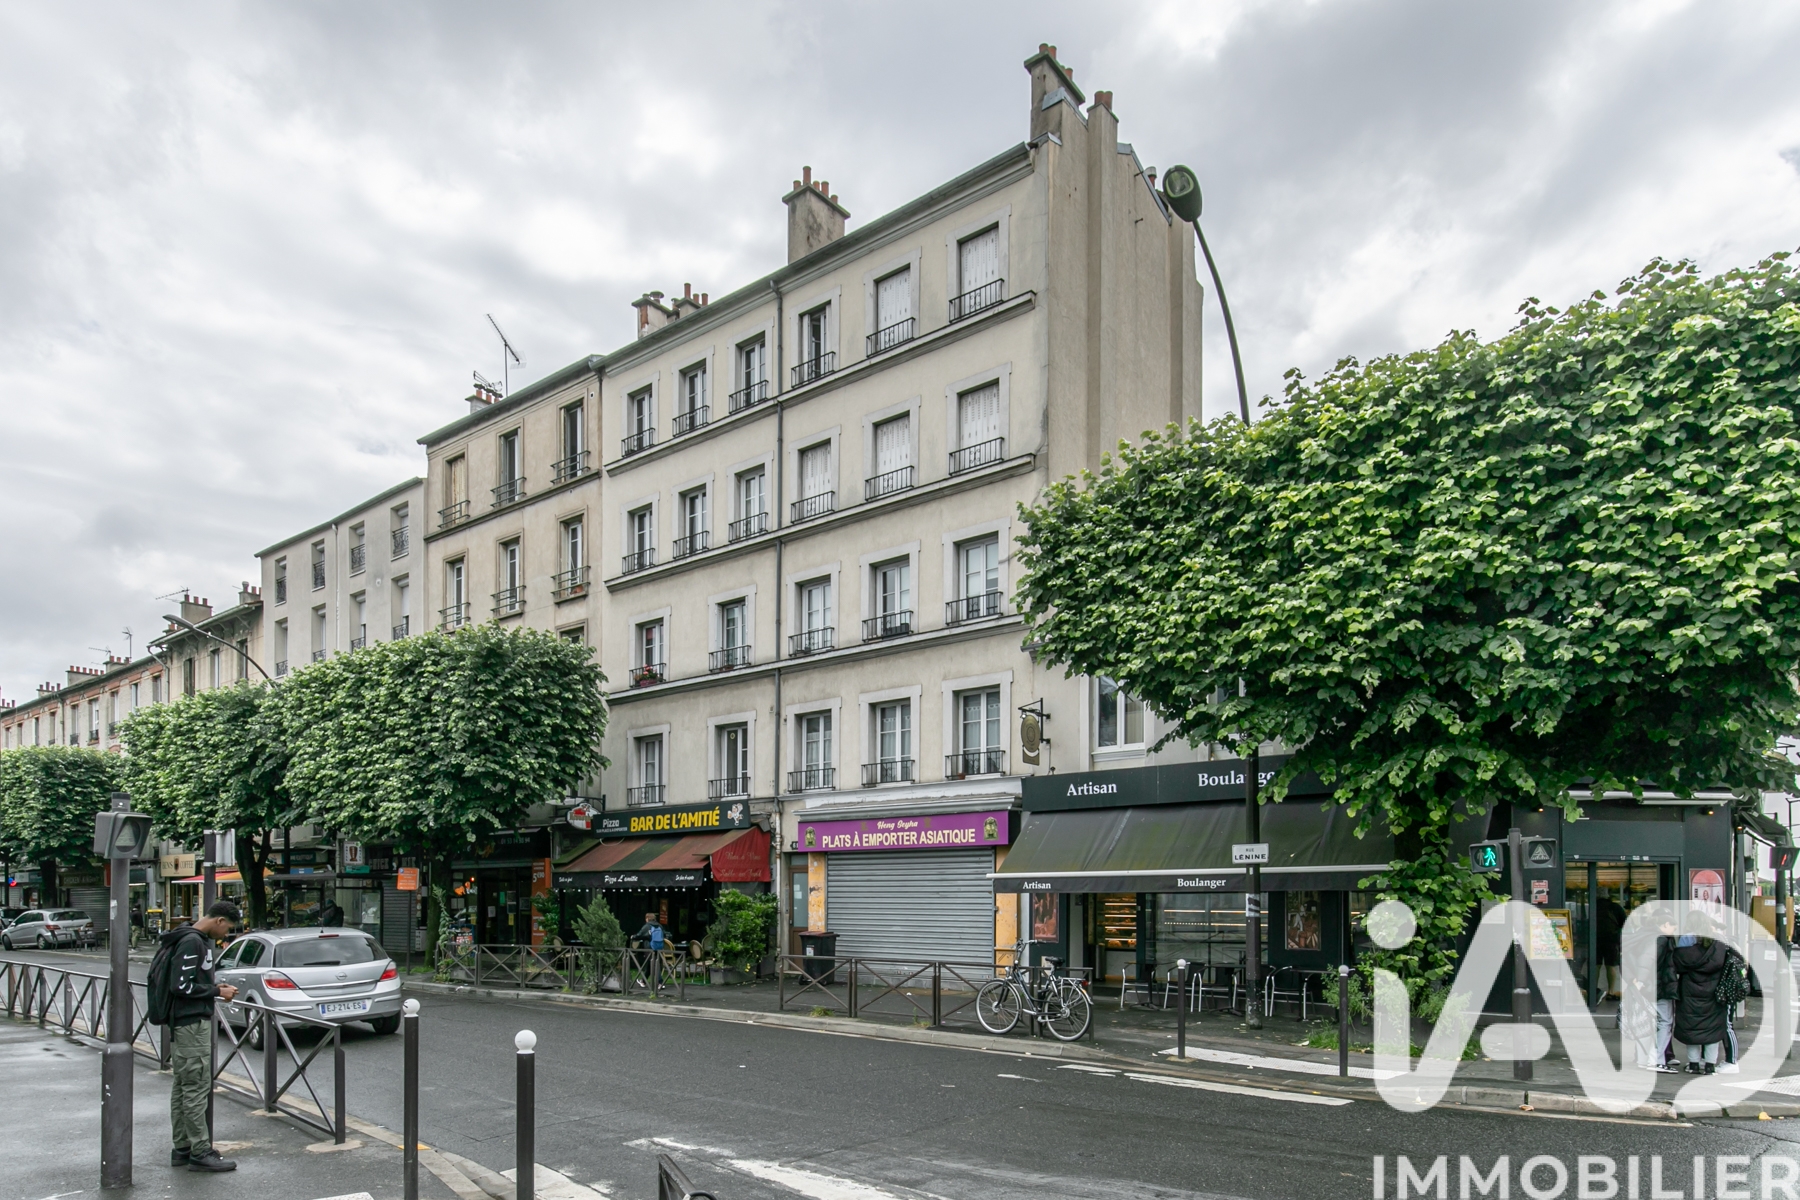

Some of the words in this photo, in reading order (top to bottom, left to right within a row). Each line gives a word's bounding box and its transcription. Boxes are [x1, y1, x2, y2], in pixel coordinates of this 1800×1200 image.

[1067, 782, 1118, 797] Artisan
[1197, 770, 1276, 788] Boulage
[602, 818, 620, 828] Pizza
[630, 815, 654, 833] BAR
[655, 814, 671, 831] DE
[672, 806, 720, 829] L'AMITIÉ
[877, 820, 895, 830] Heng
[897, 819, 918, 830] Seyha
[822, 834, 851, 848] PLATS
[853, 831, 861, 846] À
[862, 831, 918, 847] EMPORTER
[919, 828, 976, 845] ASIATIQUE
[1022, 881, 1052, 890] Artisan
[1177, 878, 1226, 889] Boulanger
